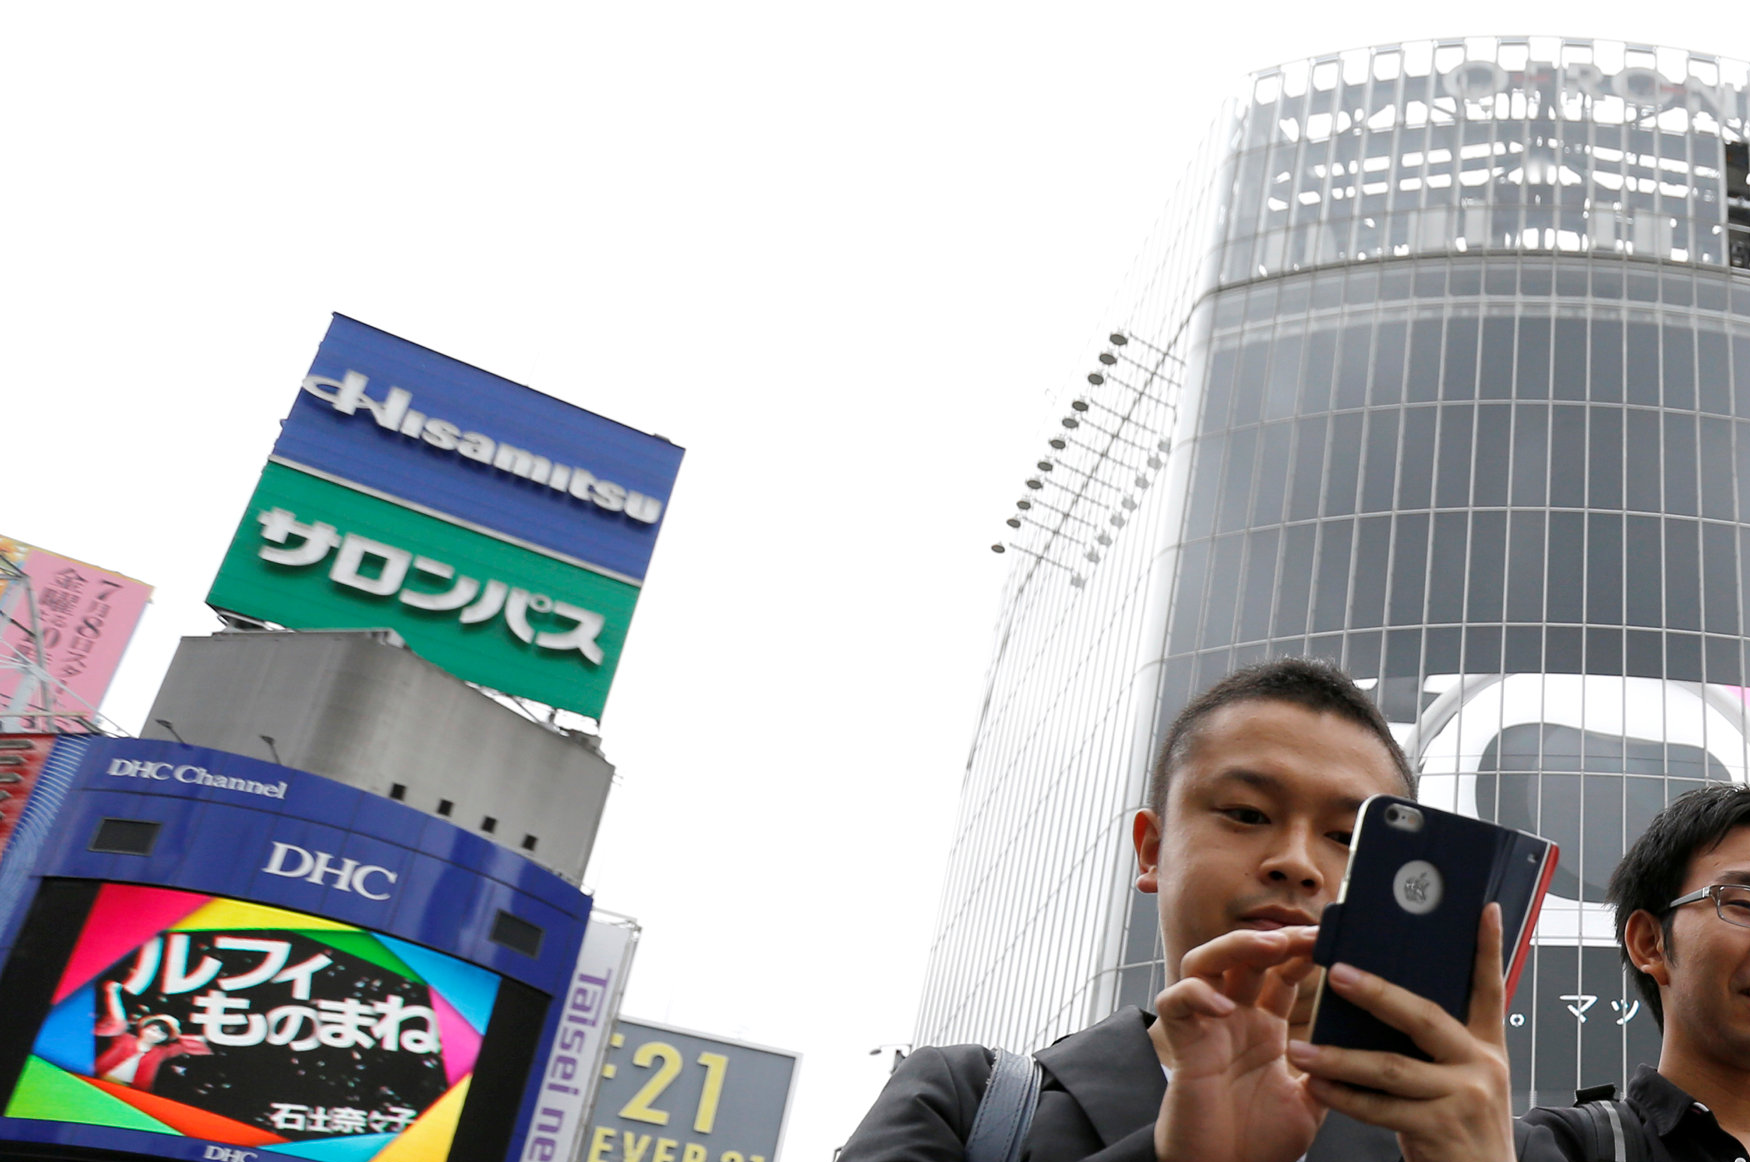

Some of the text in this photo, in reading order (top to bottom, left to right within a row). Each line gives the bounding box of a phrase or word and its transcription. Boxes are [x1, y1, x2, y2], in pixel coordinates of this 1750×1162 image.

[302, 369, 662, 525] Hisamitsu
[257, 506, 605, 667] サロンパス
[106, 757, 289, 800] DHC Channel
[261, 840, 399, 902] DHC
[123, 932, 335, 1001] ルフィ
[189, 988, 442, 1054] ものまね
[546, 967, 613, 1097] Taisei
